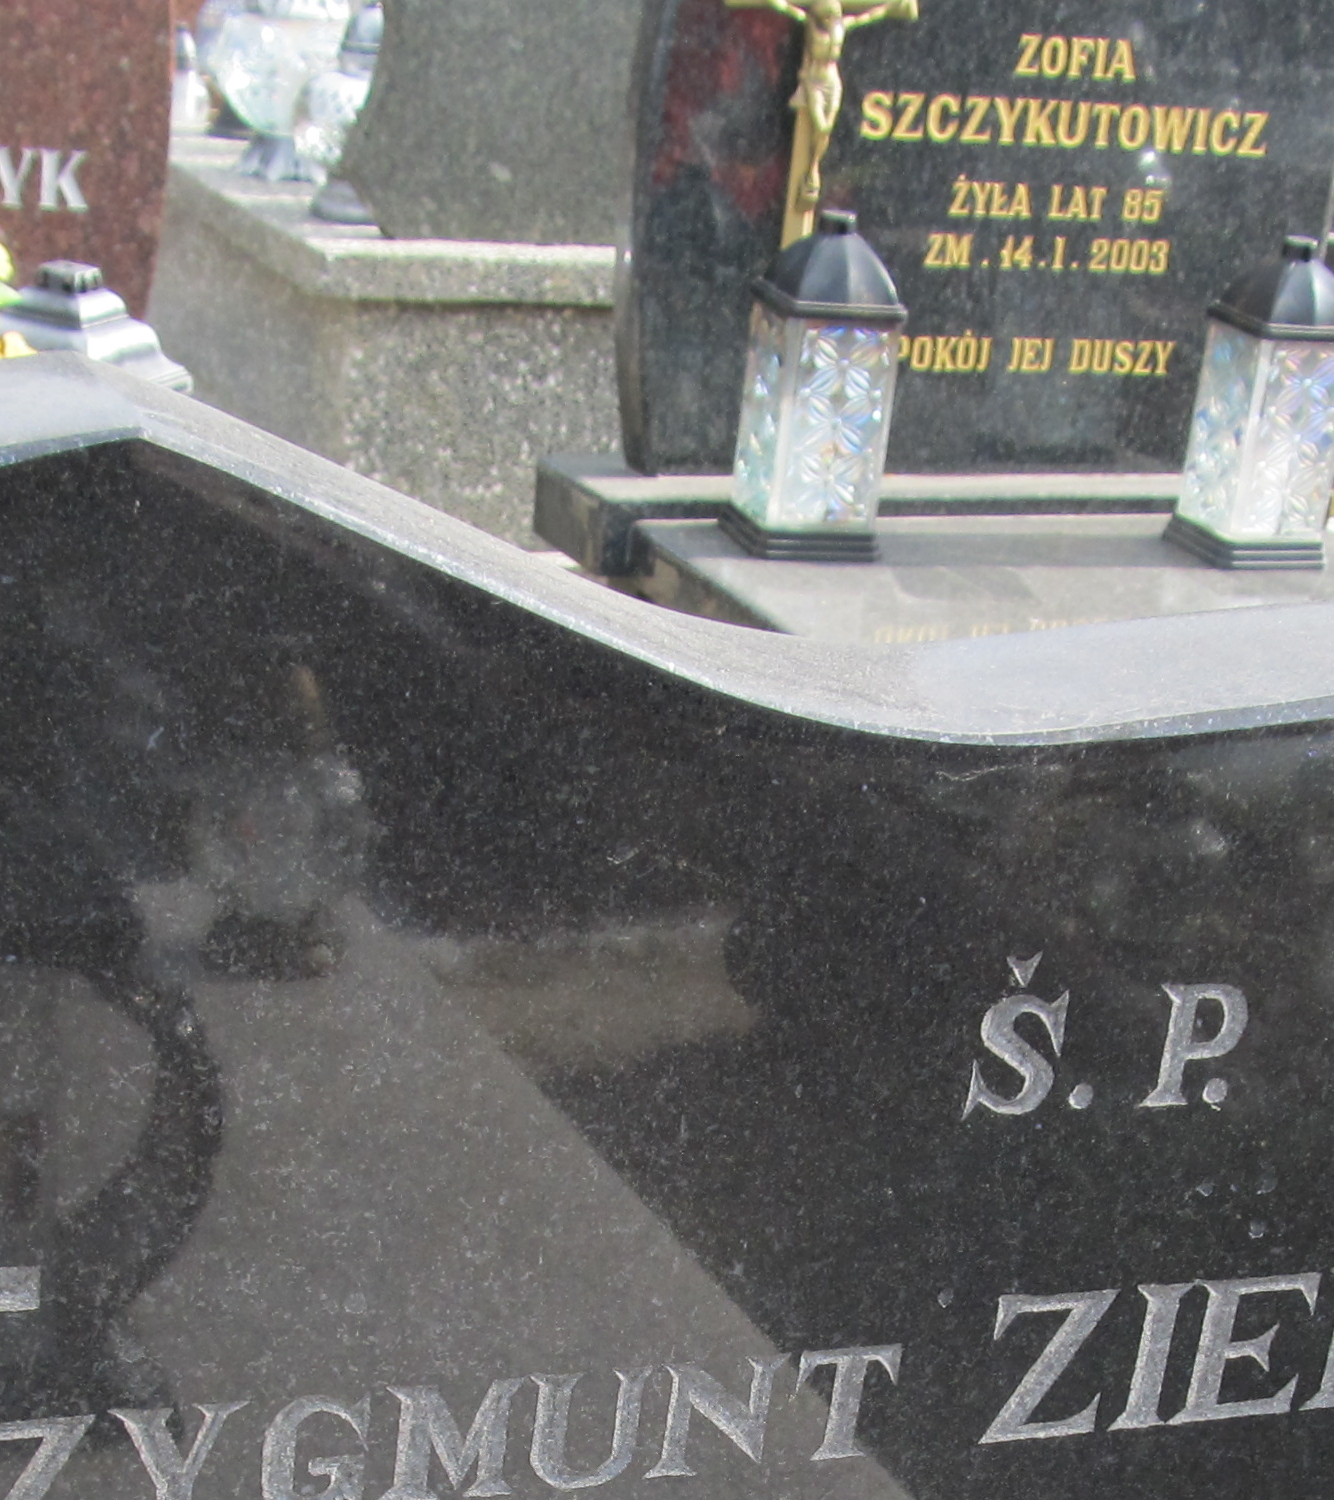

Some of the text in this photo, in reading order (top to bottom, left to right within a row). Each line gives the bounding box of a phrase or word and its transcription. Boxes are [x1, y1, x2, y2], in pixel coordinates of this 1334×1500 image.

[1015, 33, 1137, 82] ZOFIA
[860, 90, 1269, 157] SZCZYKUTOWICZ
[949, 174, 1165, 223] ŻYŁA LAT 85
[1088, 238, 1171, 274] 2003
[1007, 337, 1055, 373] JEJ
[1069, 338, 1176, 375] DUSZY
[1137, 981, 1249, 1111] P.
